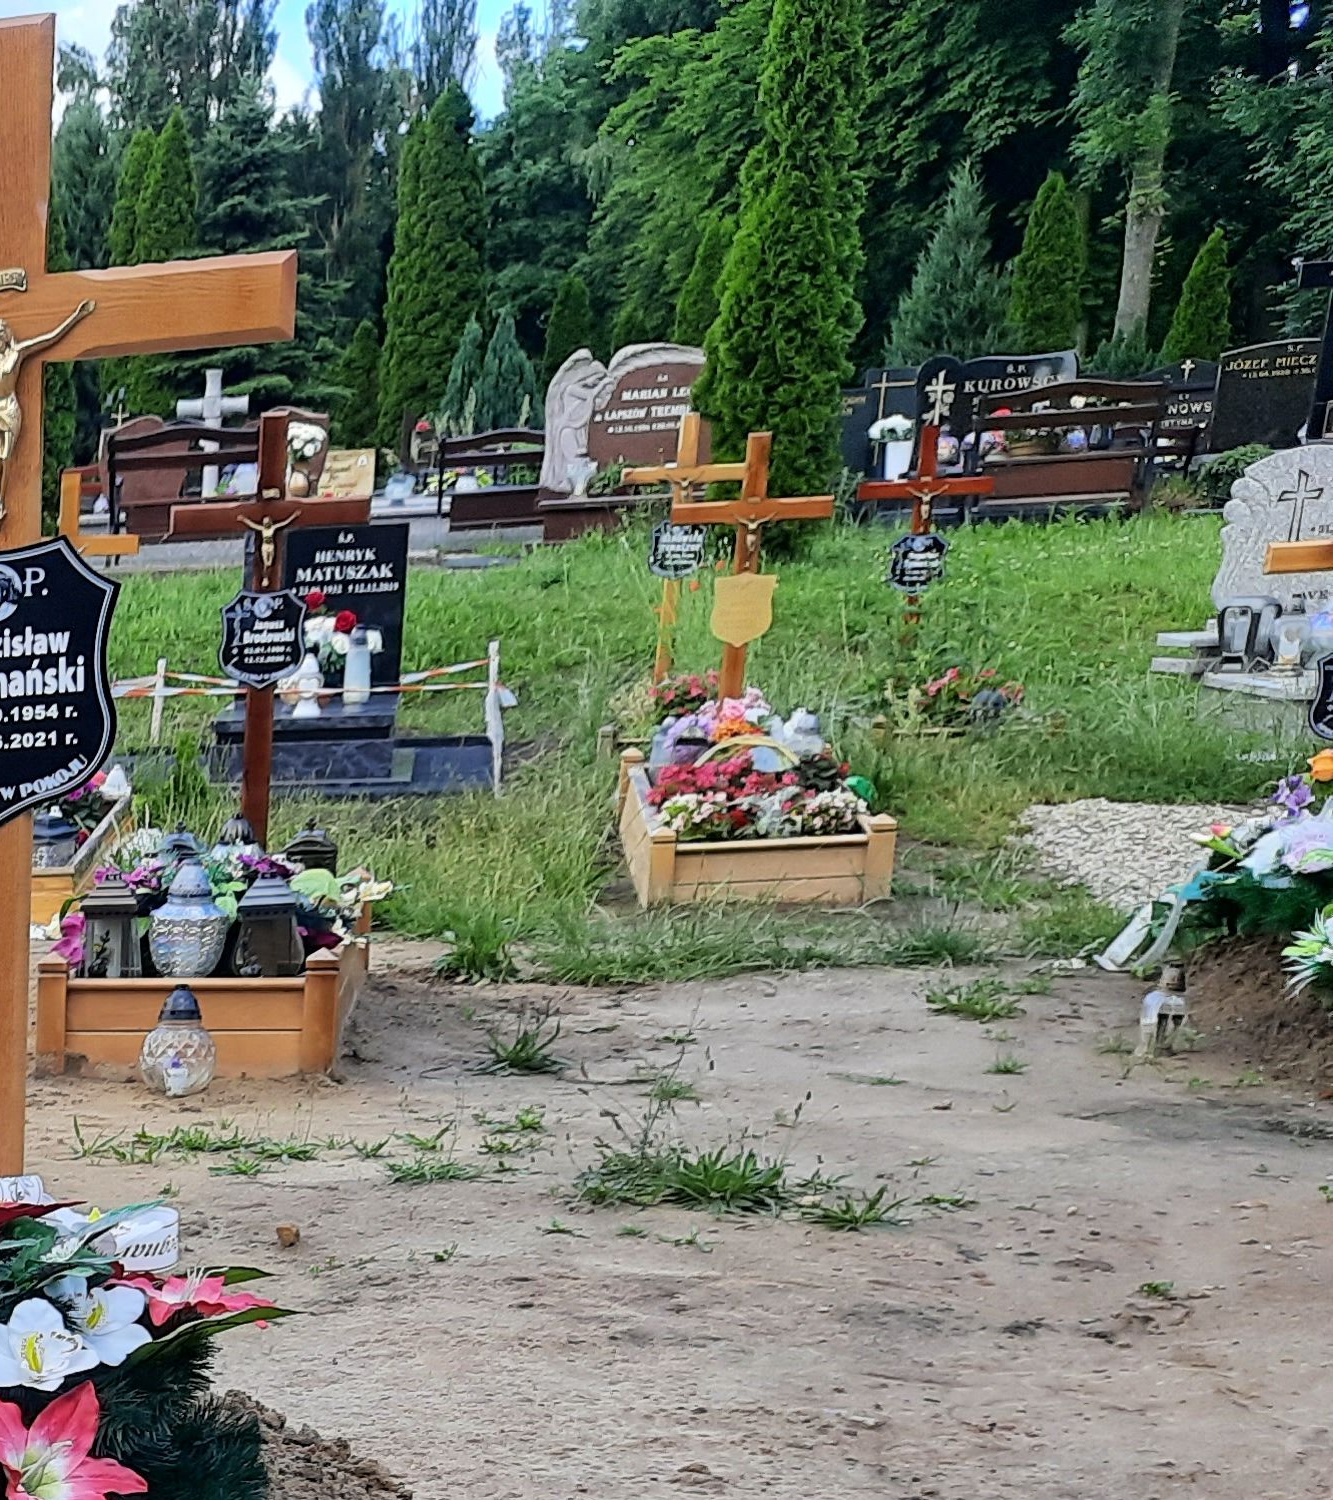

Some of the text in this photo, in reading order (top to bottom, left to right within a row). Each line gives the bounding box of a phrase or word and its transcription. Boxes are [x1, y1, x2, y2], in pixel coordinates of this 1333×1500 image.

[1225, 354, 1318, 371] JÓZEF MIECZ
[314, 547, 377, 564] HENRYK
[294, 562, 394, 583] MATUSZAK
[23, 567, 49, 597] P.
[64, 705, 79, 719] r.
[64, 732, 79, 746] r.
[0, 785, 18, 801] W
[19, 753, 89, 799] POKOJU
